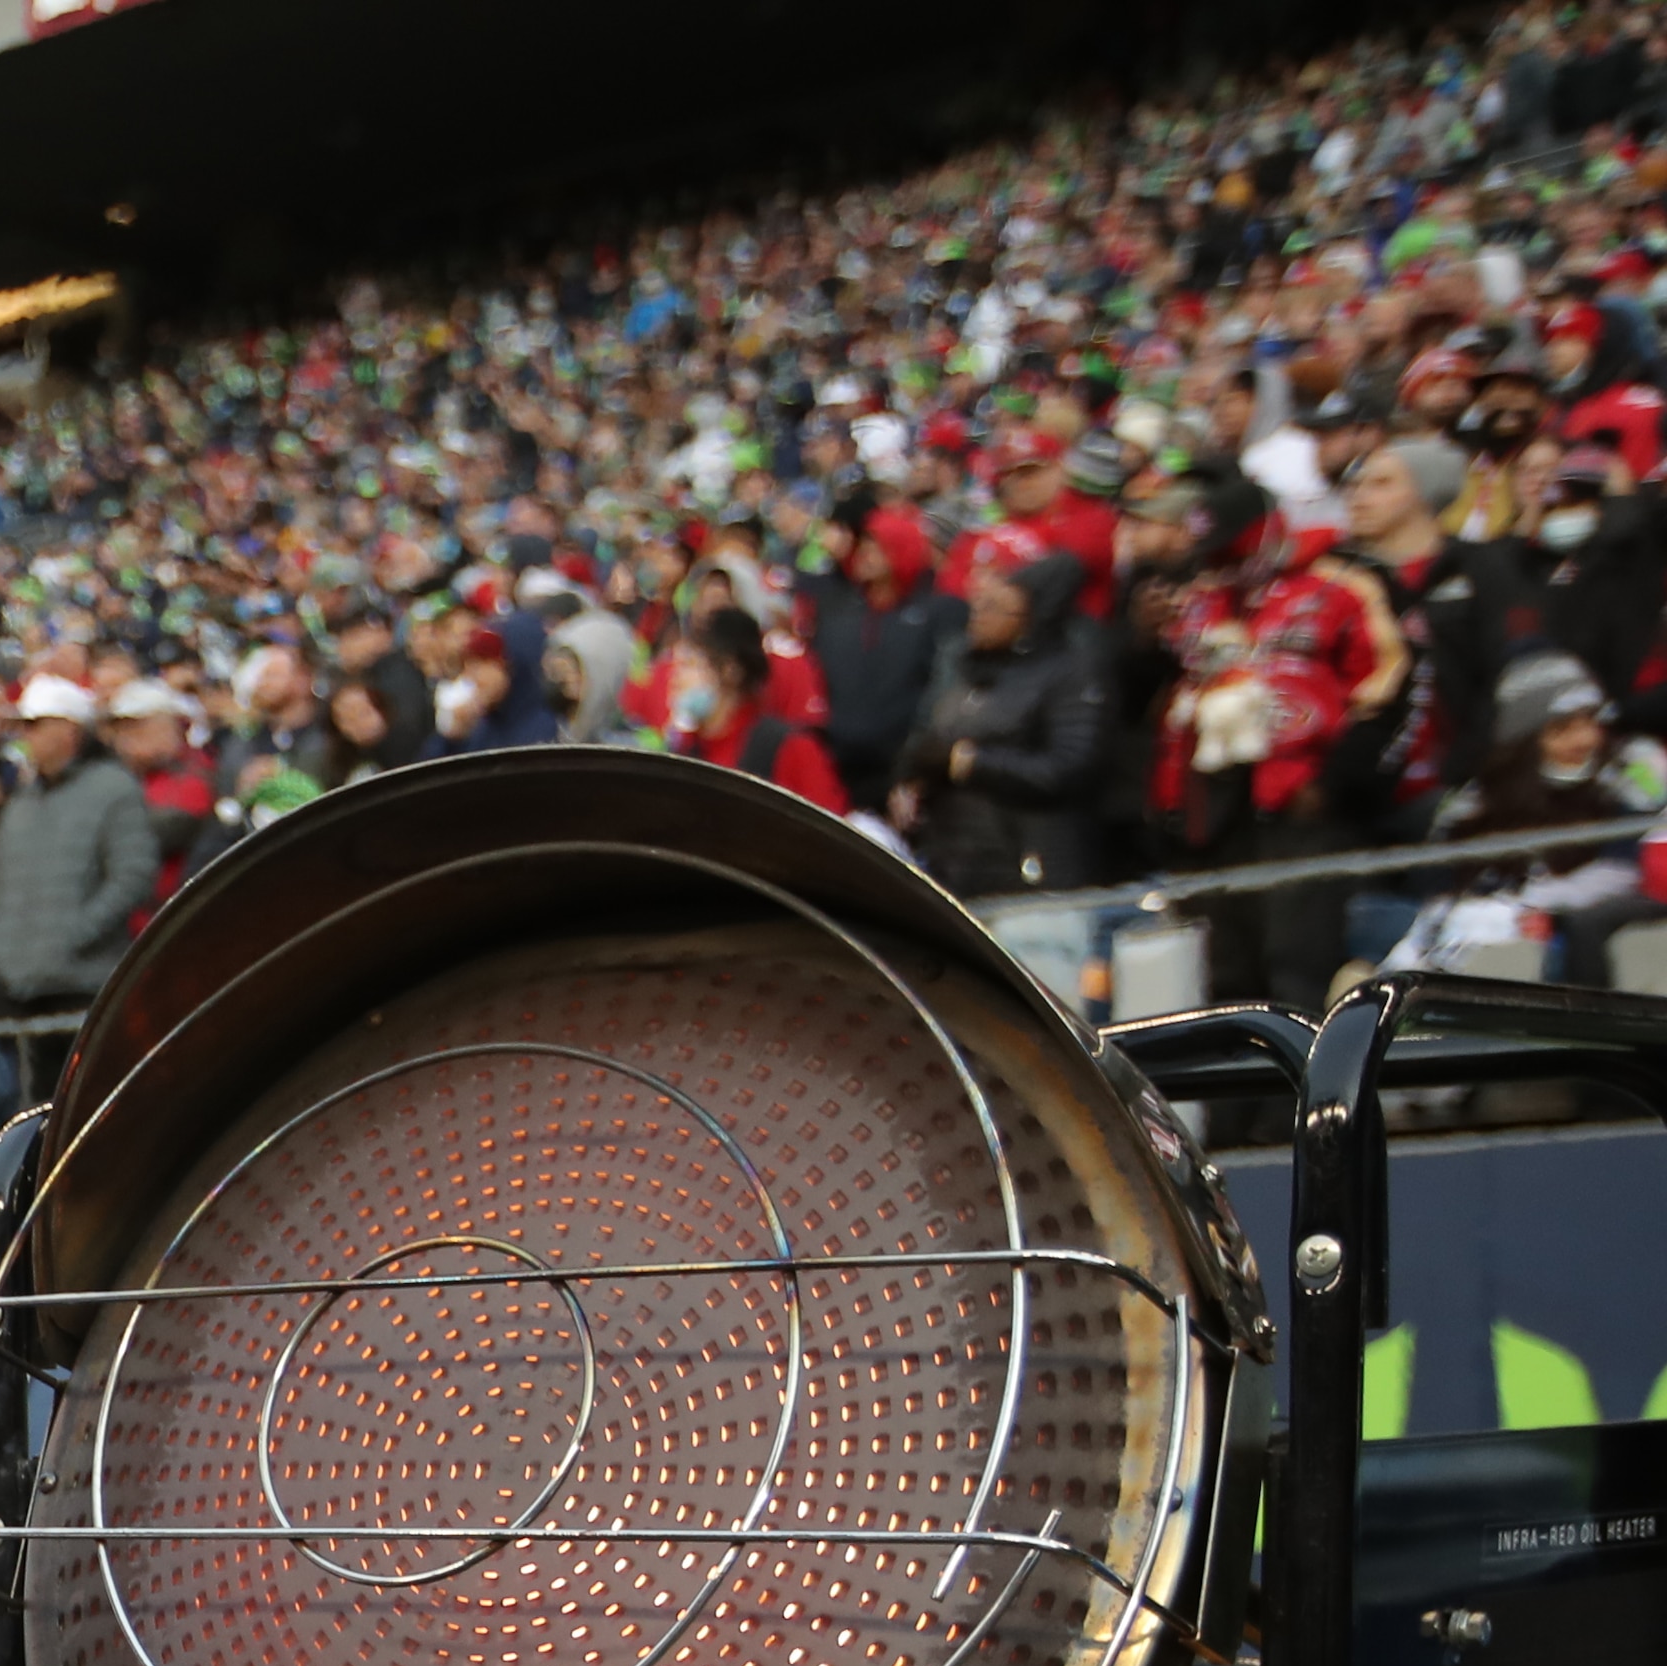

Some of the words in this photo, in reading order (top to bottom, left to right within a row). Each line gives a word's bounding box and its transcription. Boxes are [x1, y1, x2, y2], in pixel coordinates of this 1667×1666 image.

[1498, 1524, 1576, 1552] INFRA-RED
[1579, 1522, 1602, 1544] OIL
[1606, 1516, 1656, 1541] HEATER
